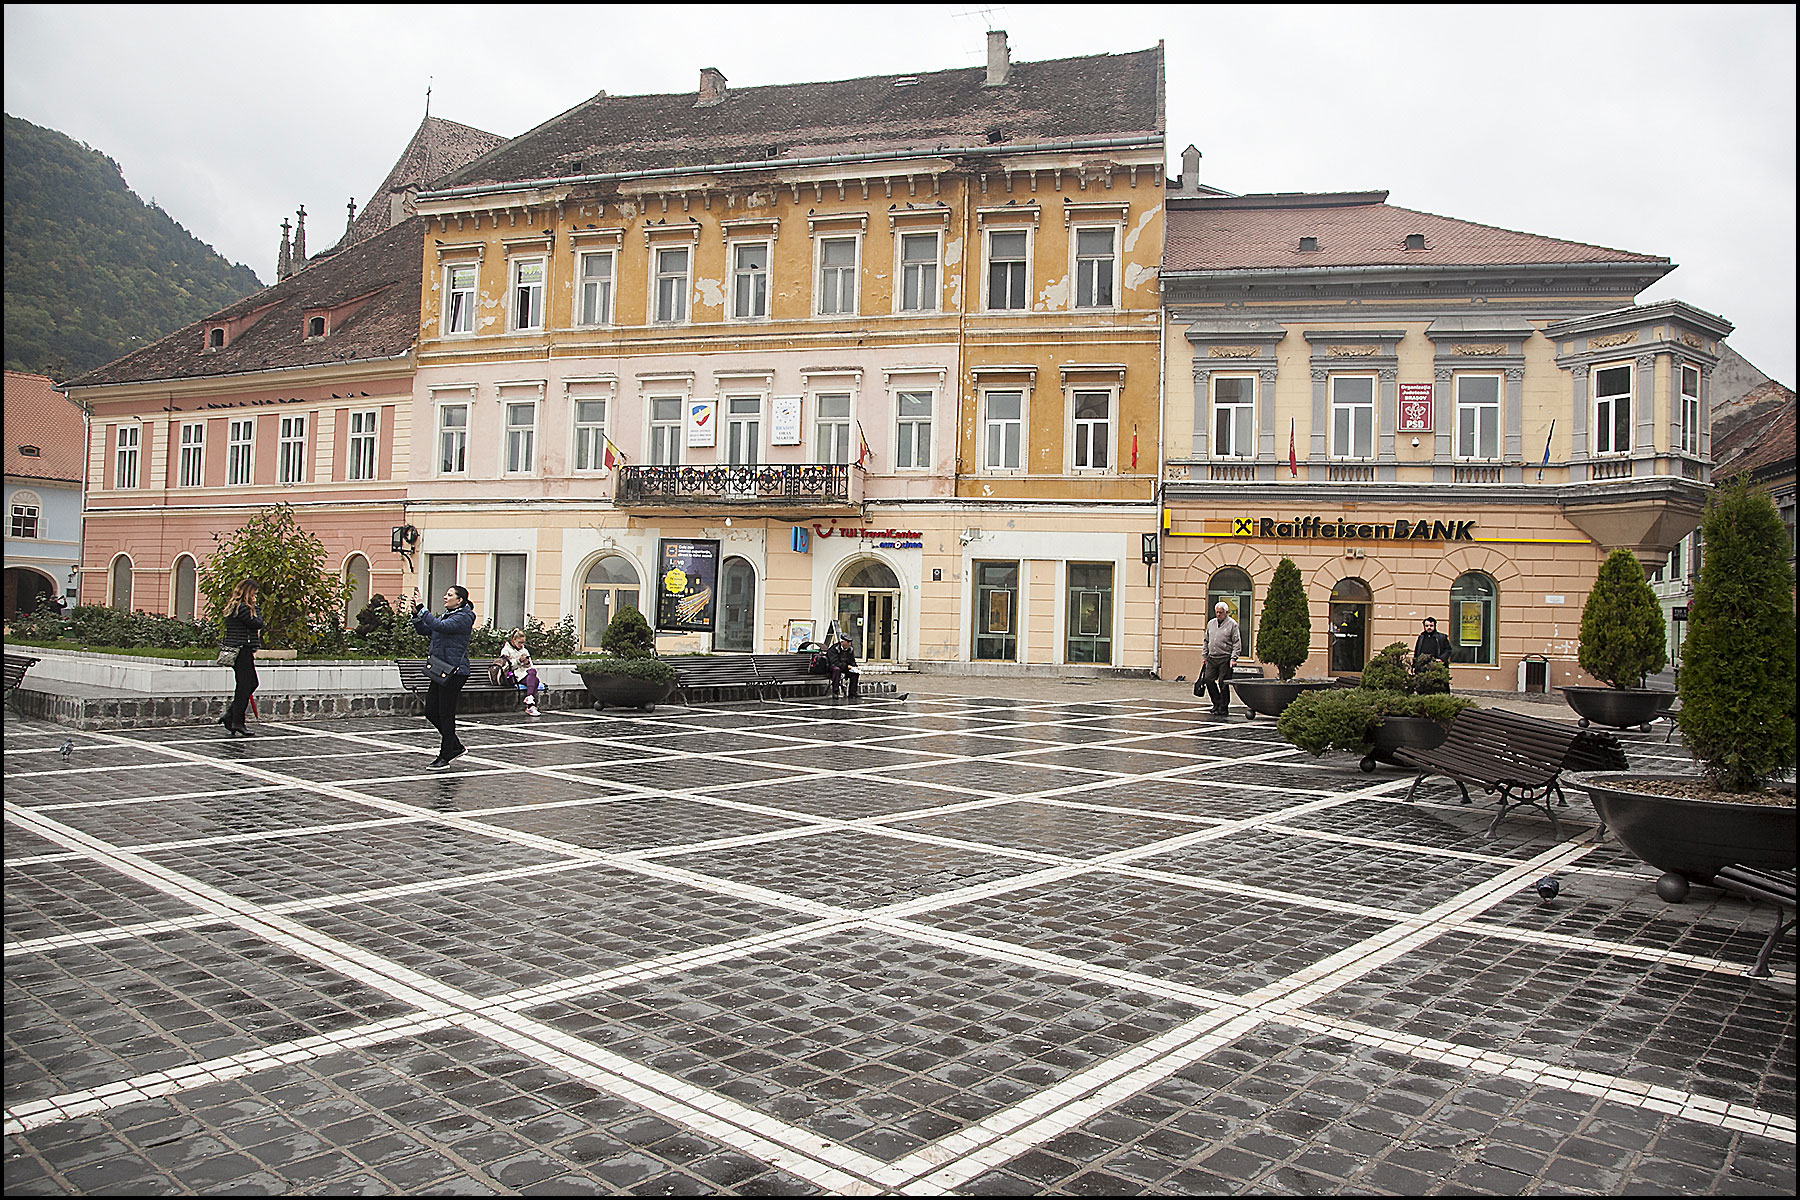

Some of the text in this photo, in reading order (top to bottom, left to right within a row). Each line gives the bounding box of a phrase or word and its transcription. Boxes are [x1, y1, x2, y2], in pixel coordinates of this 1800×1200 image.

[1406, 420, 1425, 428] PSD
[839, 527, 923, 539] TUI TravelCenter
[1259, 516, 1476, 540] Raiffeisen BANK
